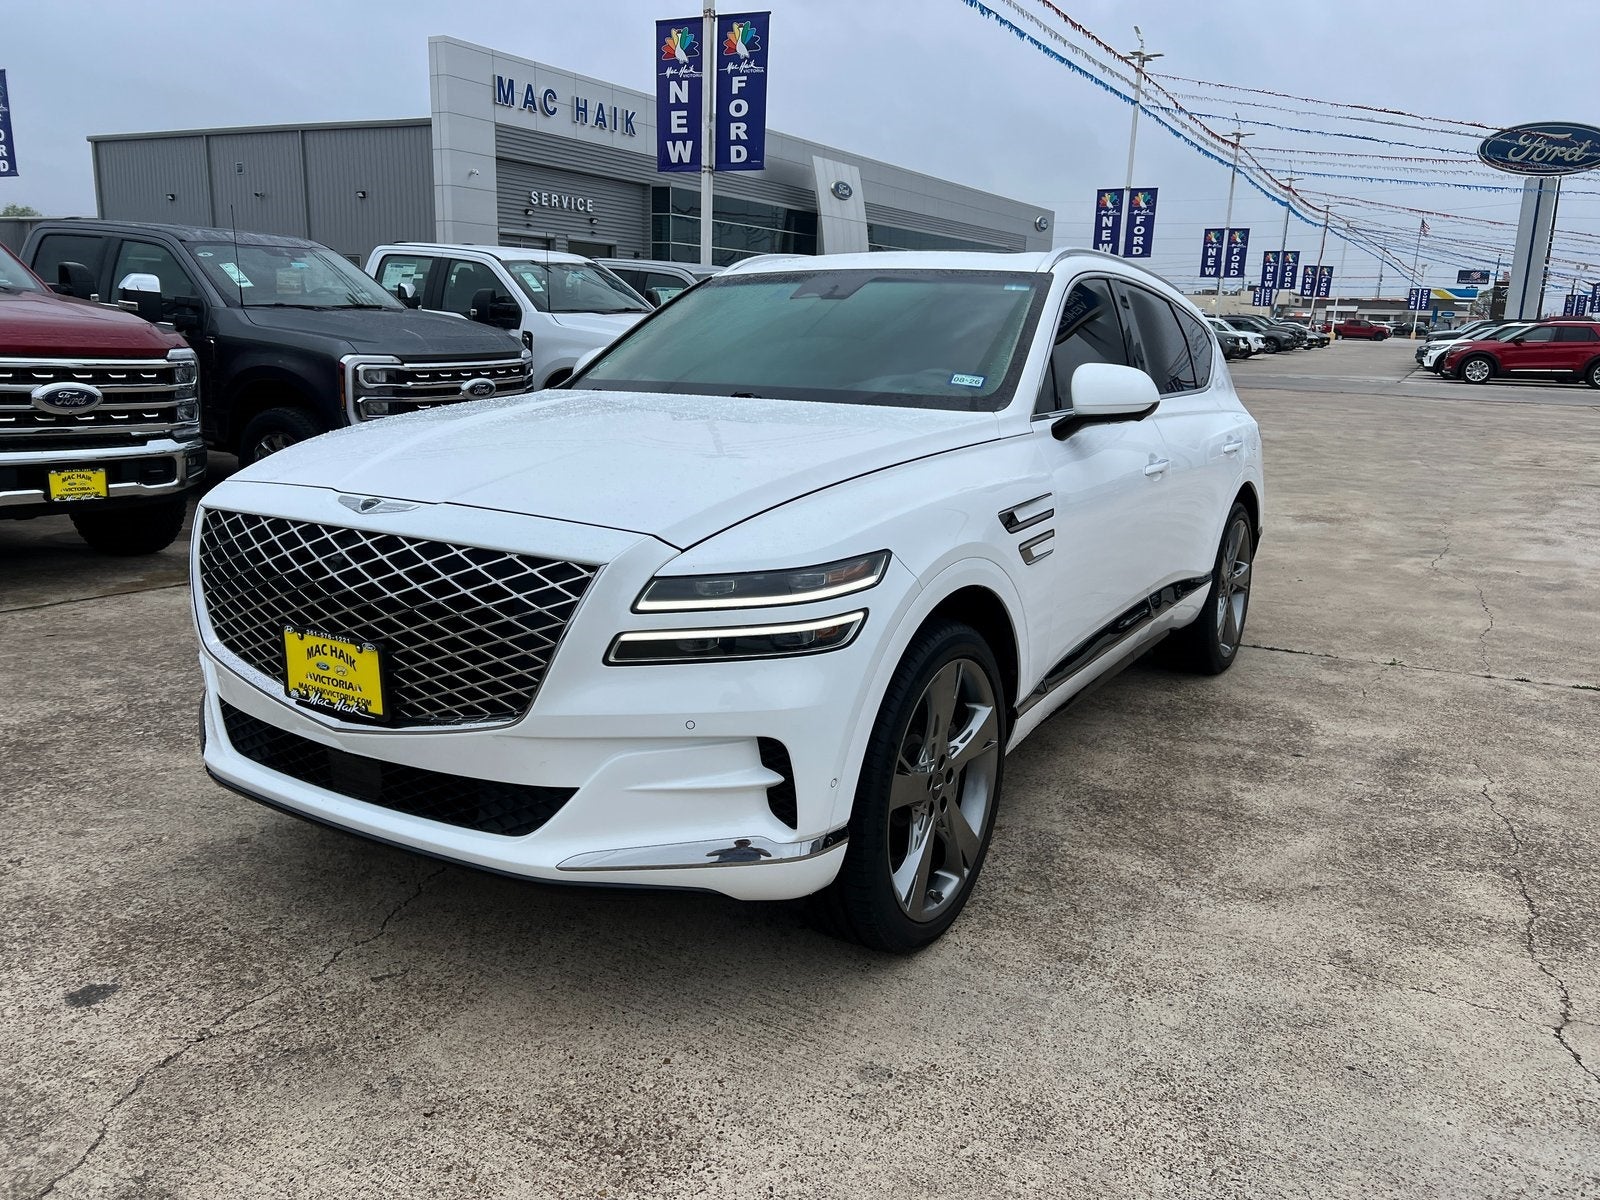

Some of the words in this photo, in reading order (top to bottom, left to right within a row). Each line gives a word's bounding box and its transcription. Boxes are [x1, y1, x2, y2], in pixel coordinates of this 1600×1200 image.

[494, 74, 558, 117] MAC
[573, 95, 637, 136] HAIK
[666, 80, 693, 164] NEW
[729, 76, 749, 163] FORD
[0, 113, 9, 172] ORD
[1507, 131, 1592, 162] Ford
[530, 190, 594, 212] SERVICE
[1099, 216, 1113, 254] NEW
[1132, 215, 1146, 255] FORD
[1205, 247, 1217, 276] NEW
[1230, 247, 1241, 276] FORD
[1264, 265, 1274, 288] NEW
[1284, 265, 1293, 288] FORD
[1303, 277, 1312, 296] NEW
[1319, 278, 1328, 296] FORD
[54, 391, 87, 406] Ford
[61, 474, 75, 483] MAC
[77, 473, 92, 482] HAIK
[307, 644, 328, 660] MAC
[330, 645, 357, 672] HAIK
[312, 673, 354, 692] VICTORIA
[308, 692, 333, 707] Mac
[333, 699, 365, 715] Haik
